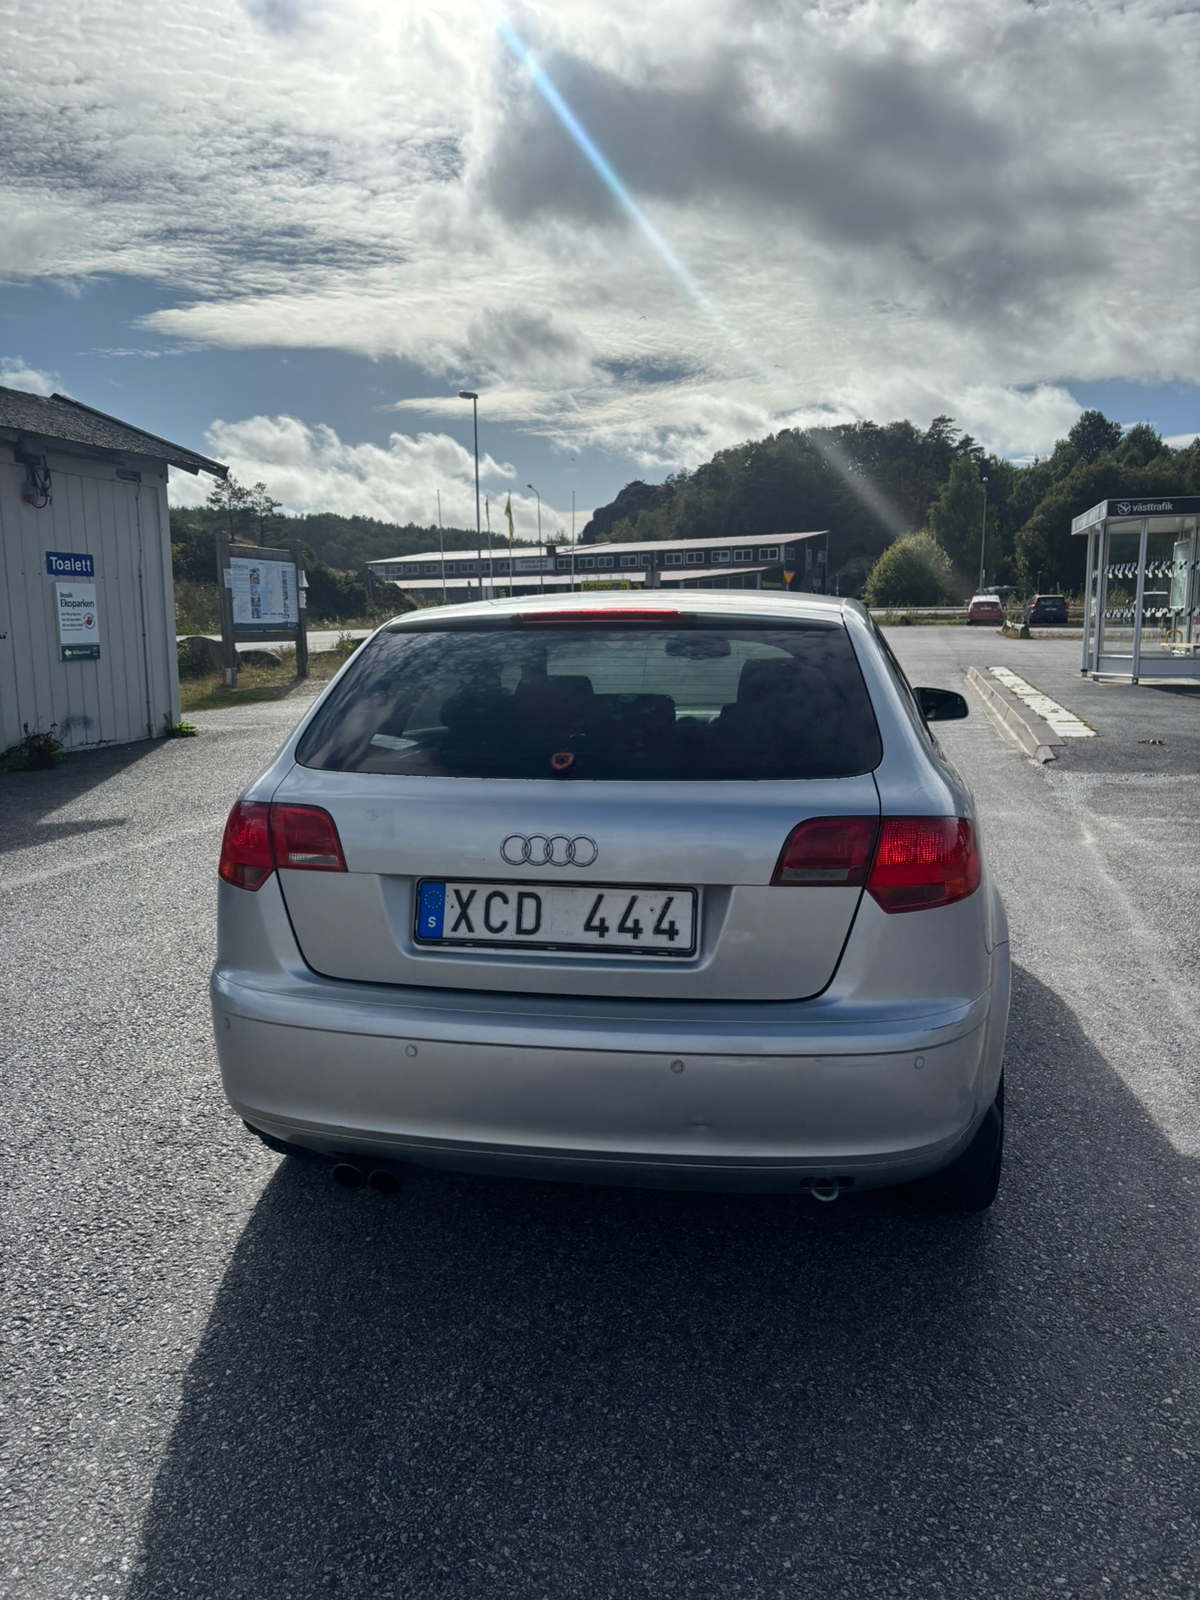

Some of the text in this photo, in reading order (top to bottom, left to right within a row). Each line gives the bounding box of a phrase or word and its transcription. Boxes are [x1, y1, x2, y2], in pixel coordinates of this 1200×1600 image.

[1132, 502, 1173, 512] västtrafik
[49, 556, 92, 572] Toalett
[60, 598, 95, 610] Ekoparken
[451, 889, 679, 941] XCD 444
[427, 916, 437, 928] S
